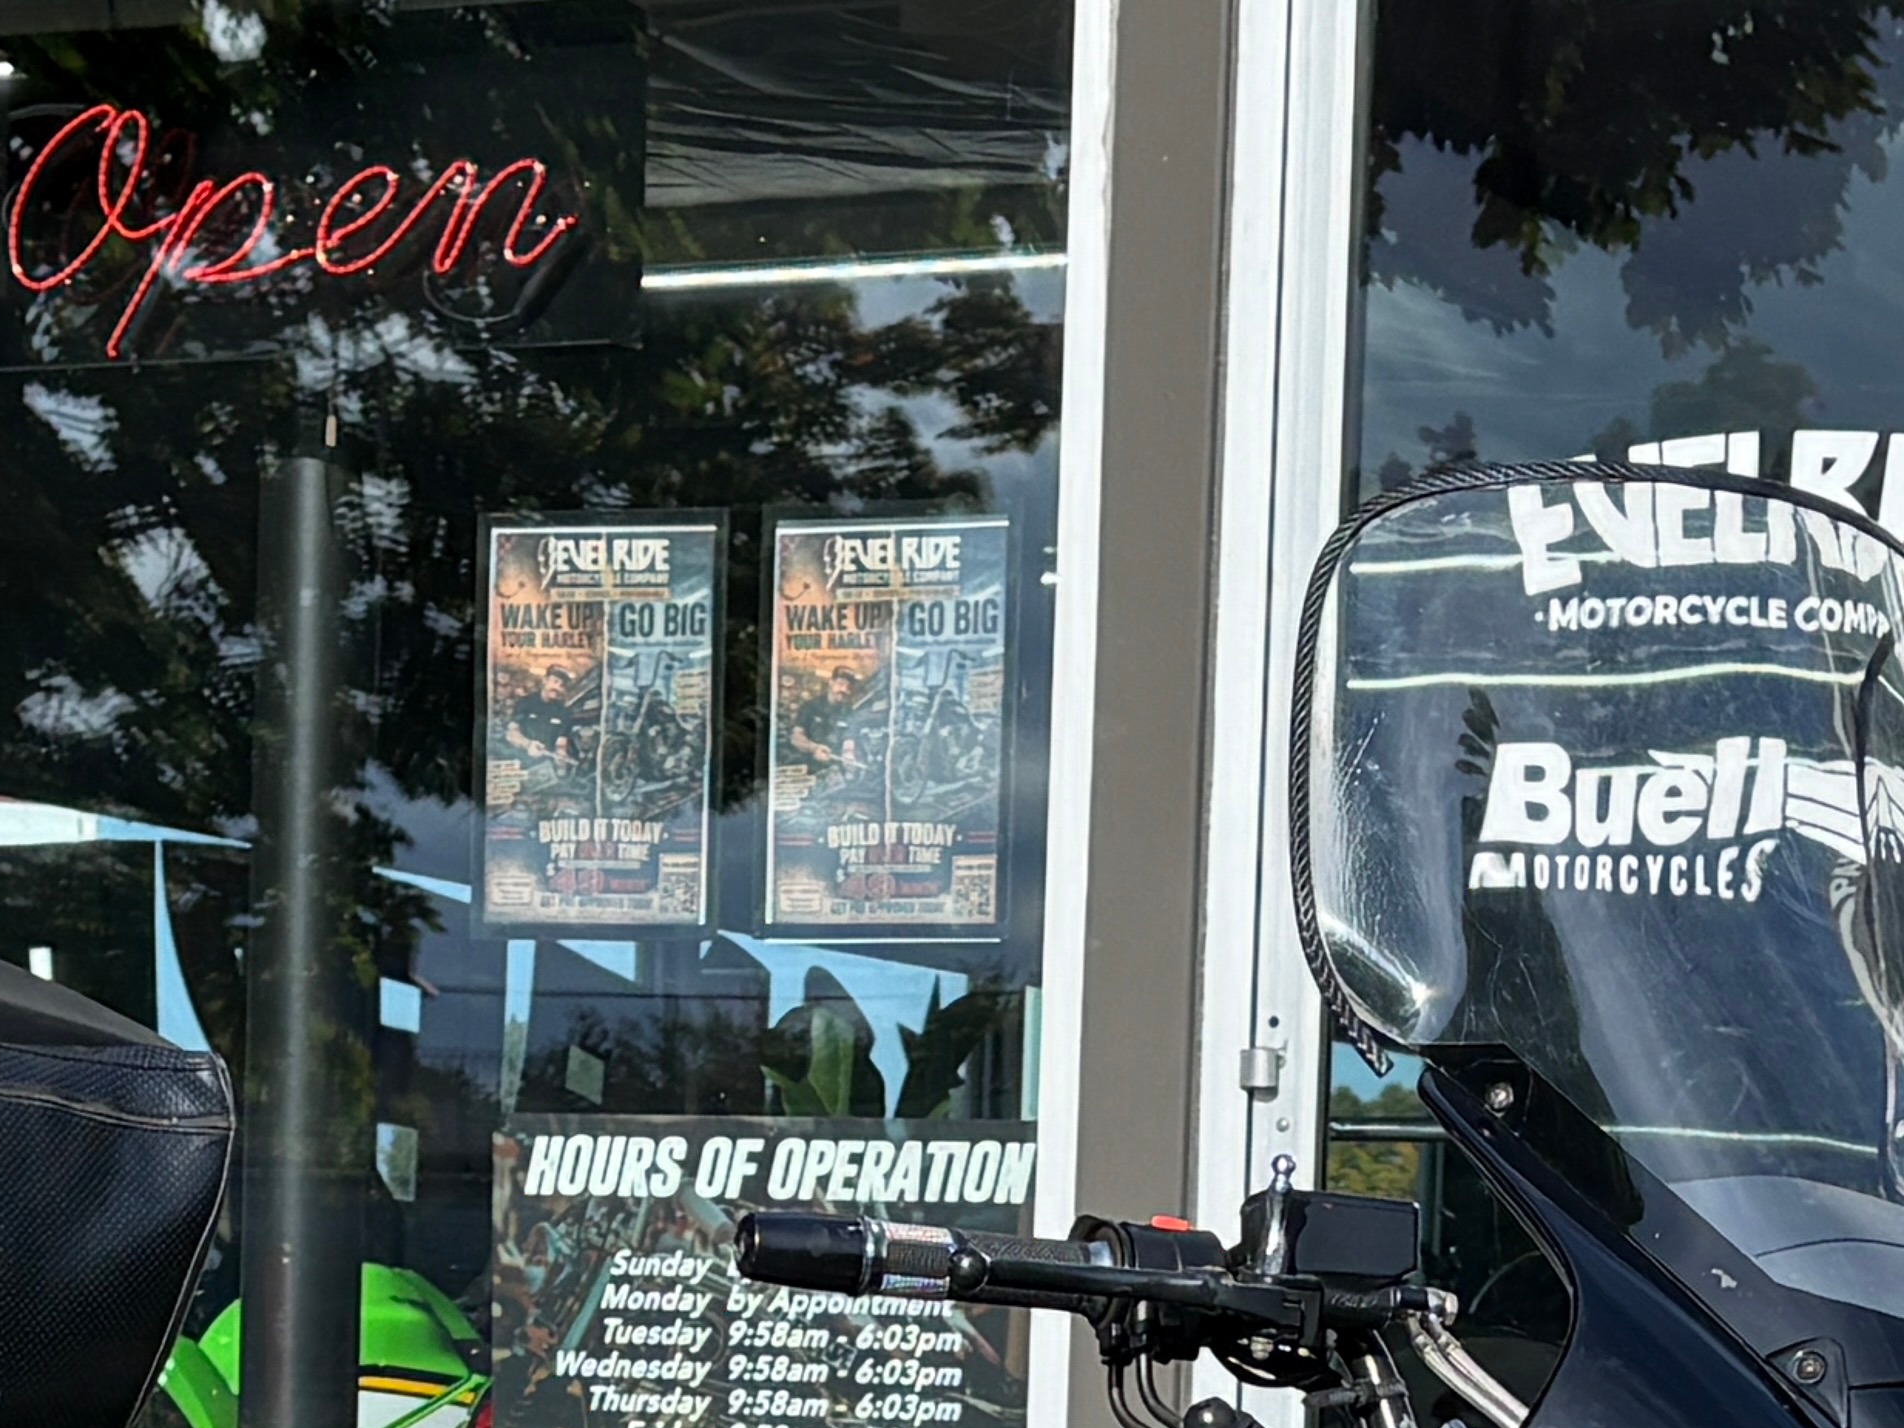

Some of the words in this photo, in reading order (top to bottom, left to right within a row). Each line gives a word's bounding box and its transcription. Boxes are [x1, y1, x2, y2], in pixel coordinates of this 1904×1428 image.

[7, 103, 577, 358] Open
[503, 604, 561, 629] WAKE
[568, 604, 595, 629] UP
[620, 603, 654, 637] GO
[664, 602, 706, 636] BIG
[787, 605, 847, 631] WAKE
[855, 601, 882, 630] UP
[909, 602, 944, 637] GO
[954, 599, 999, 635] BIG
[1549, 594, 1788, 632] MOTORCYCLE
[1479, 735, 1786, 848] Buell
[538, 820, 590, 842] BUILD
[611, 819, 664, 844] TODAY
[827, 823, 880, 848] BUILD
[902, 823, 956, 847] TODAY
[1469, 838, 1778, 902] MOTORCYCLES
[525, 1134, 685, 1197] HOURS
[695, 1136, 763, 1199] OF
[768, 1140, 1036, 1204] OPERATION
[611, 1251, 712, 1279] Sunday
[601, 1285, 712, 1313] Monday
[728, 1290, 762, 1315] by
[604, 1319, 712, 1348] Tuesday
[727, 1321, 829, 1348] 9:58am
[855, 1321, 963, 1353] 6:03pm
[556, 1353, 712, 1381] Wednesday
[727, 1355, 828, 1382] 9:58am
[854, 1358, 963, 1388] 6:03pm
[589, 1386, 712, 1416] Thursday
[727, 1389, 828, 1417] 9:58am
[854, 1392, 962, 1423] 6:03pm
